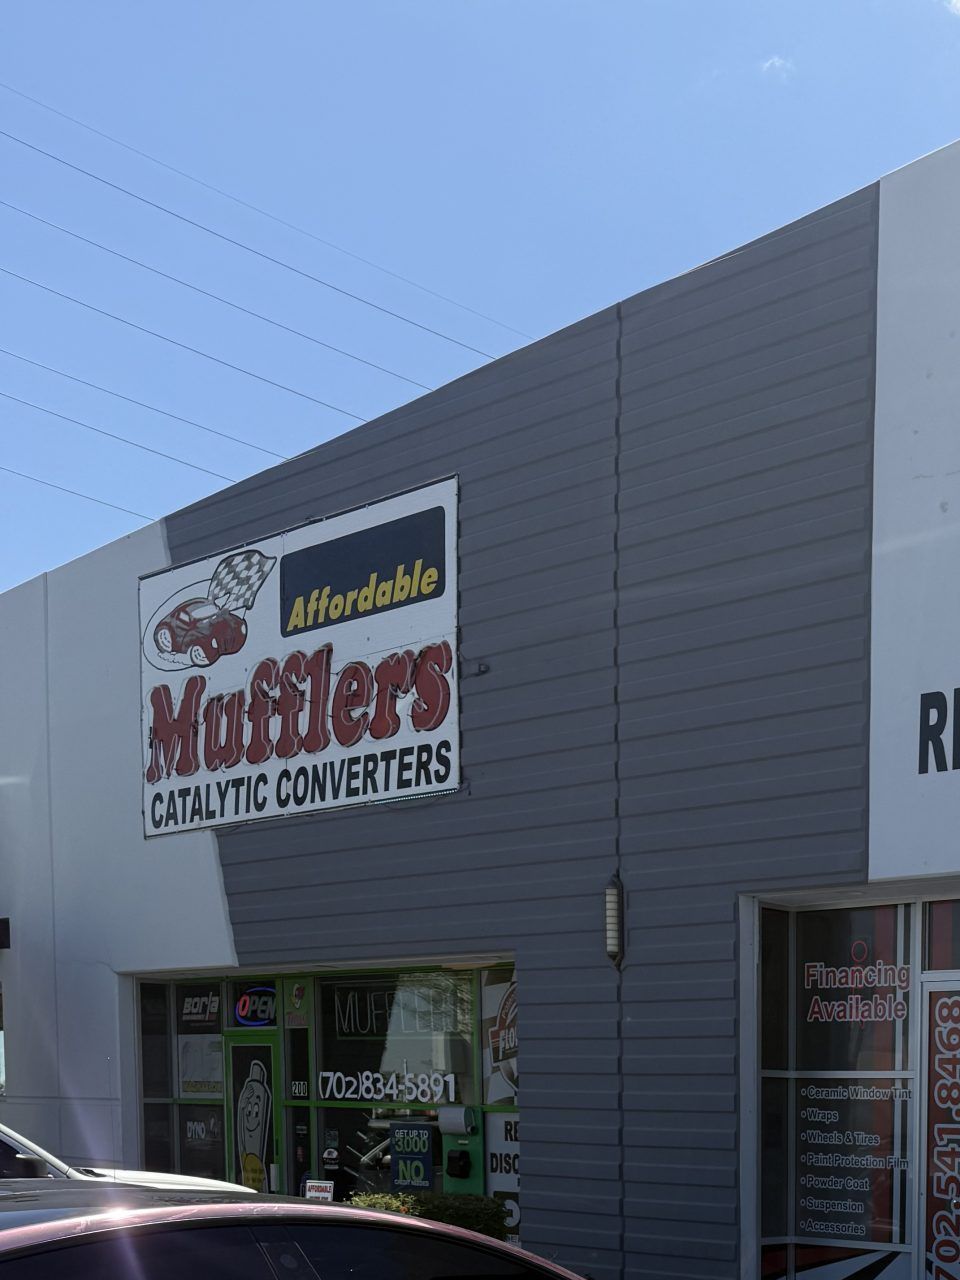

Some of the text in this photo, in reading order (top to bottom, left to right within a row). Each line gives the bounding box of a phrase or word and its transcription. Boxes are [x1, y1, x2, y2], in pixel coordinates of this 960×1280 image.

[286, 558, 439, 632] Affordable
[145, 640, 453, 784] Mufflers
[150, 739, 452, 829] CATALYTIC CONVERTERS
[804, 961, 910, 990] Financing
[238, 994, 276, 1019] OPEN
[807, 995, 908, 1022] Available
[292, 1081, 308, 1097] 200
[318, 1071, 455, 1103] (702)834-5891
[807, 1086, 912, 1101] Ceramic Window Tint
[807, 1108, 838, 1124] Wraps
[394, 1129, 429, 1138] GET UP TO
[807, 1132, 880, 1147] Wheels & Tires
[398, 1159, 425, 1181] NO
[807, 1154, 909, 1170] Paint Protection Film
[308, 1184, 332, 1193] AFFORDABLE
[807, 1176, 869, 1190] Powder Coat
[807, 1197, 864, 1214] Suspension
[806, 1220, 865, 1236] Accessories
